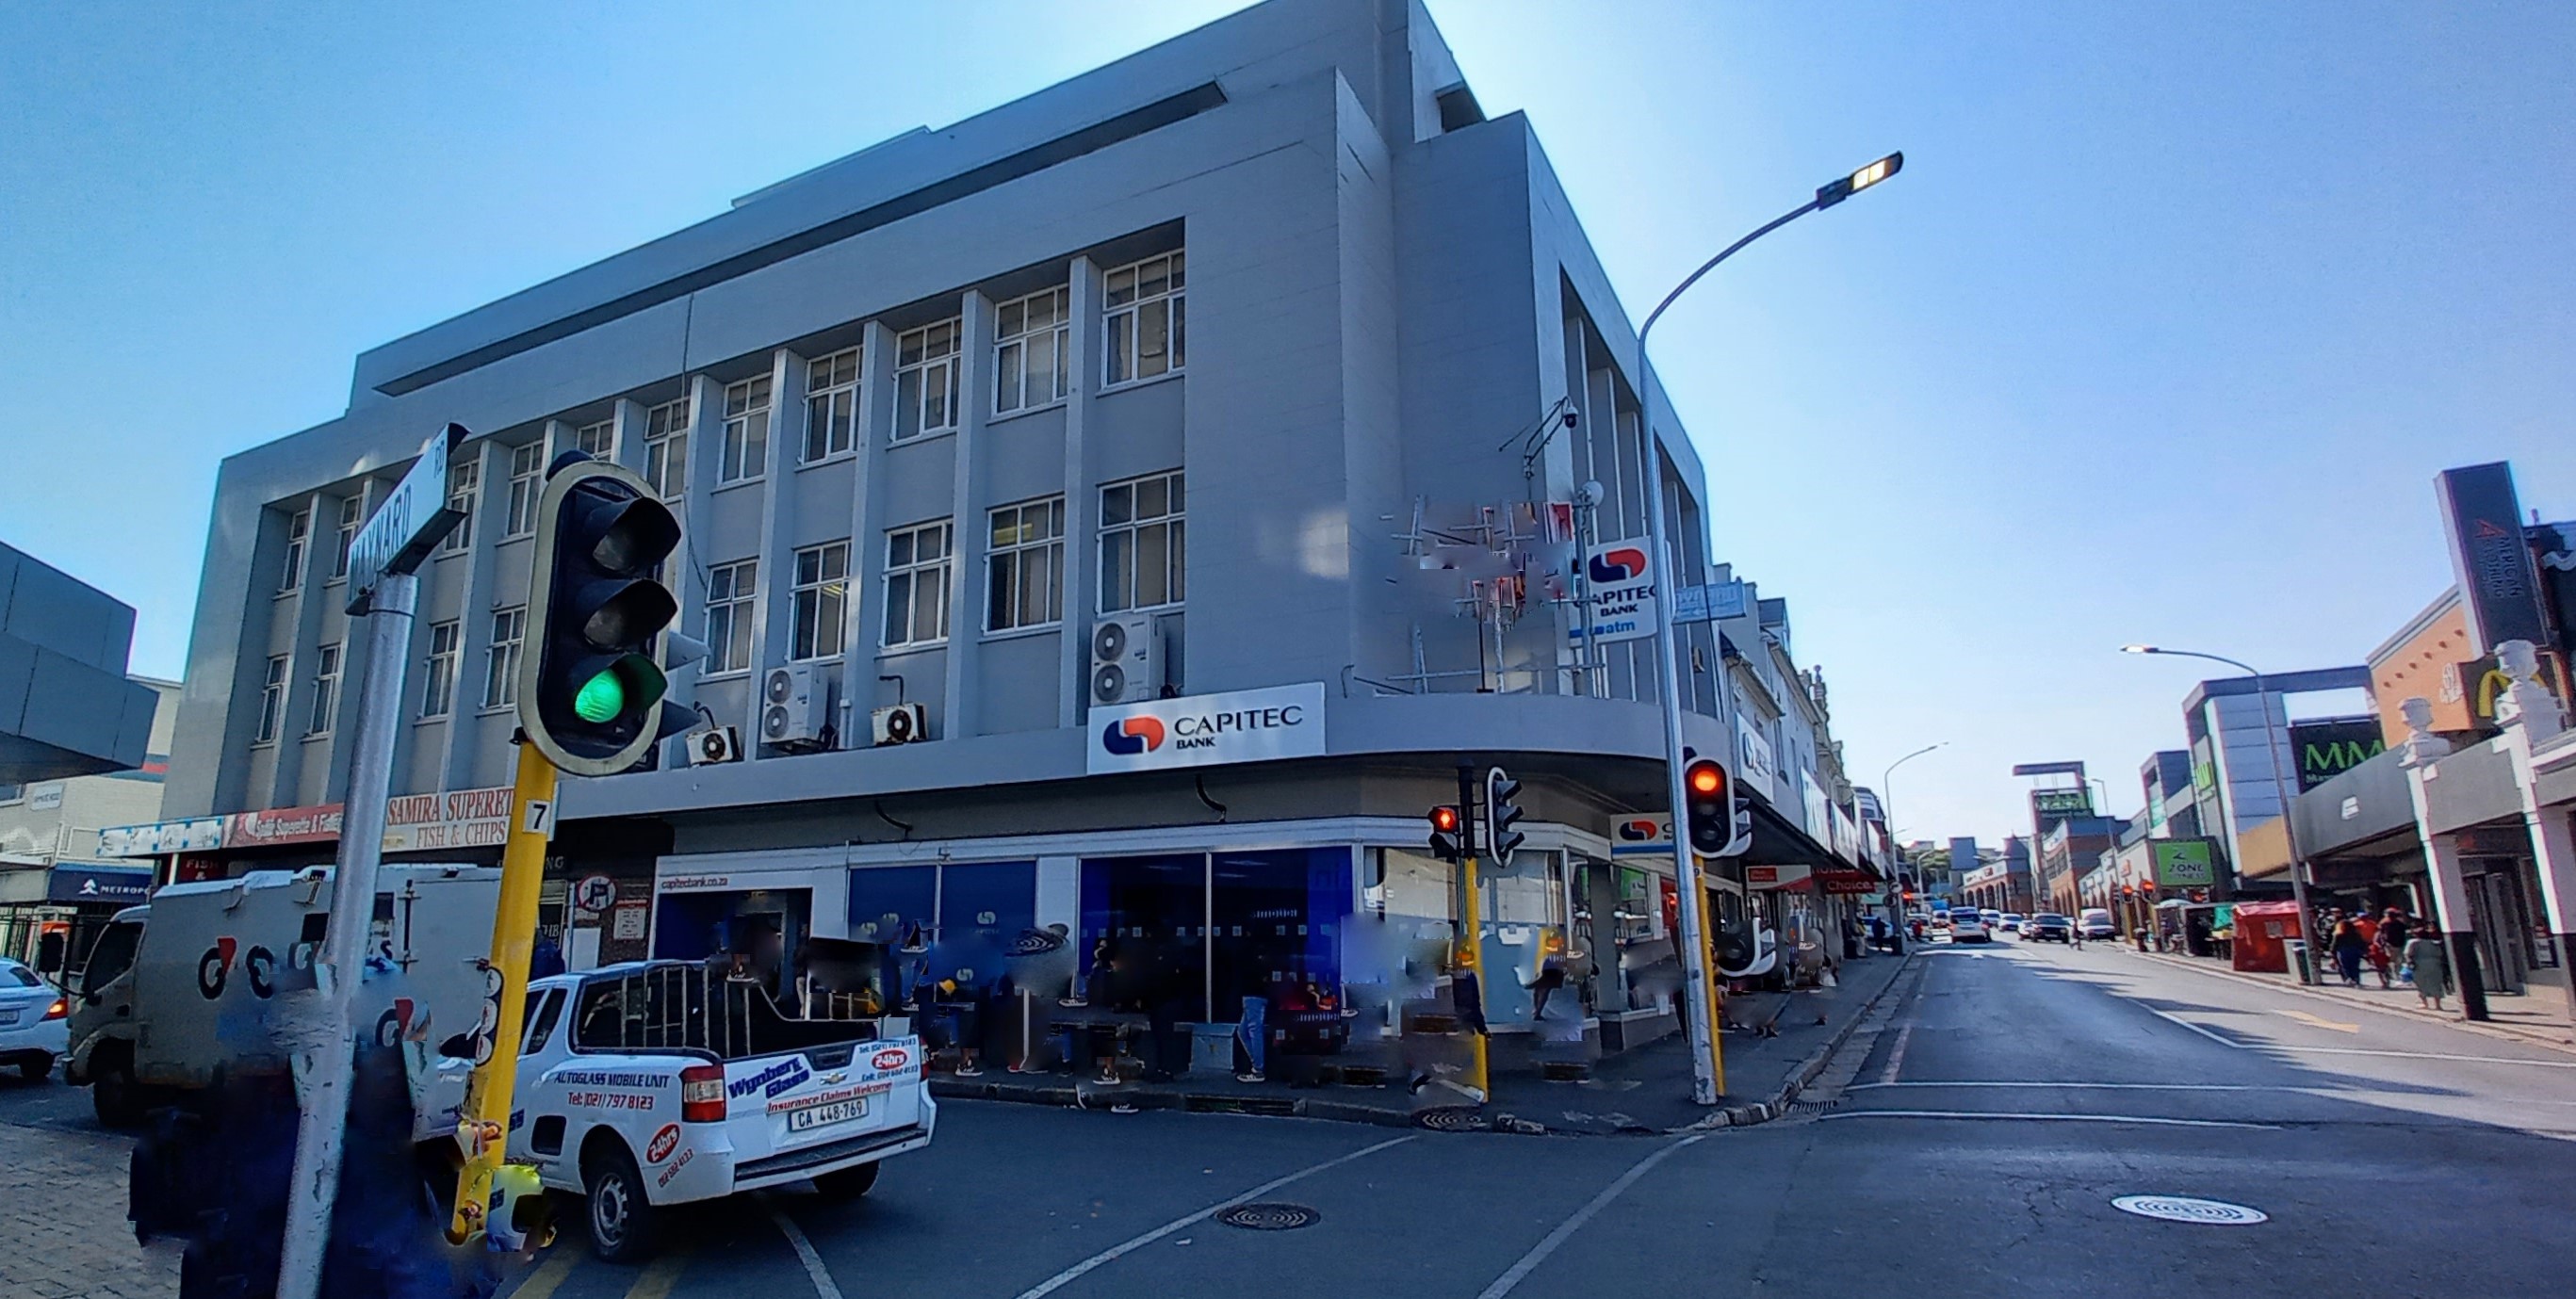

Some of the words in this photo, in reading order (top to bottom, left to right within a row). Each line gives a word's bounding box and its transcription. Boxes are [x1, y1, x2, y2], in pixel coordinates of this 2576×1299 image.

[349, 483, 412, 601] MAYNARD
[434, 439, 446, 479] RD
[1601, 603, 1639, 617] BANK
[1606, 619, 1636, 634] atm
[1173, 705, 1304, 737] CAPITEC
[1175, 736, 1216, 750] BANK
[387, 794, 441, 826] SAMIRA
[446, 788, 515, 822] SUPERET
[532, 804, 547, 830] 7
[416, 825, 446, 849] FISH
[450, 824, 461, 846] &
[465, 820, 507, 845] CHIPS
[874, 1052, 905, 1067] 24hrs
[608, 1074, 644, 1087] MOBILE
[645, 1076, 670, 1089] UNIT
[727, 1057, 804, 1099] Wynberg
[765, 1069, 810, 1099] Glass
[567, 1092, 582, 1106] Tel:
[606, 1095, 628, 1109] 797
[628, 1096, 654, 1110] 8123
[767, 1096, 819, 1113] Insurance
[821, 1088, 852, 1102] Claims
[853, 1081, 892, 1097] Welcome
[797, 1110, 813, 1128] CA
[648, 1128, 677, 1162] 24hrs
